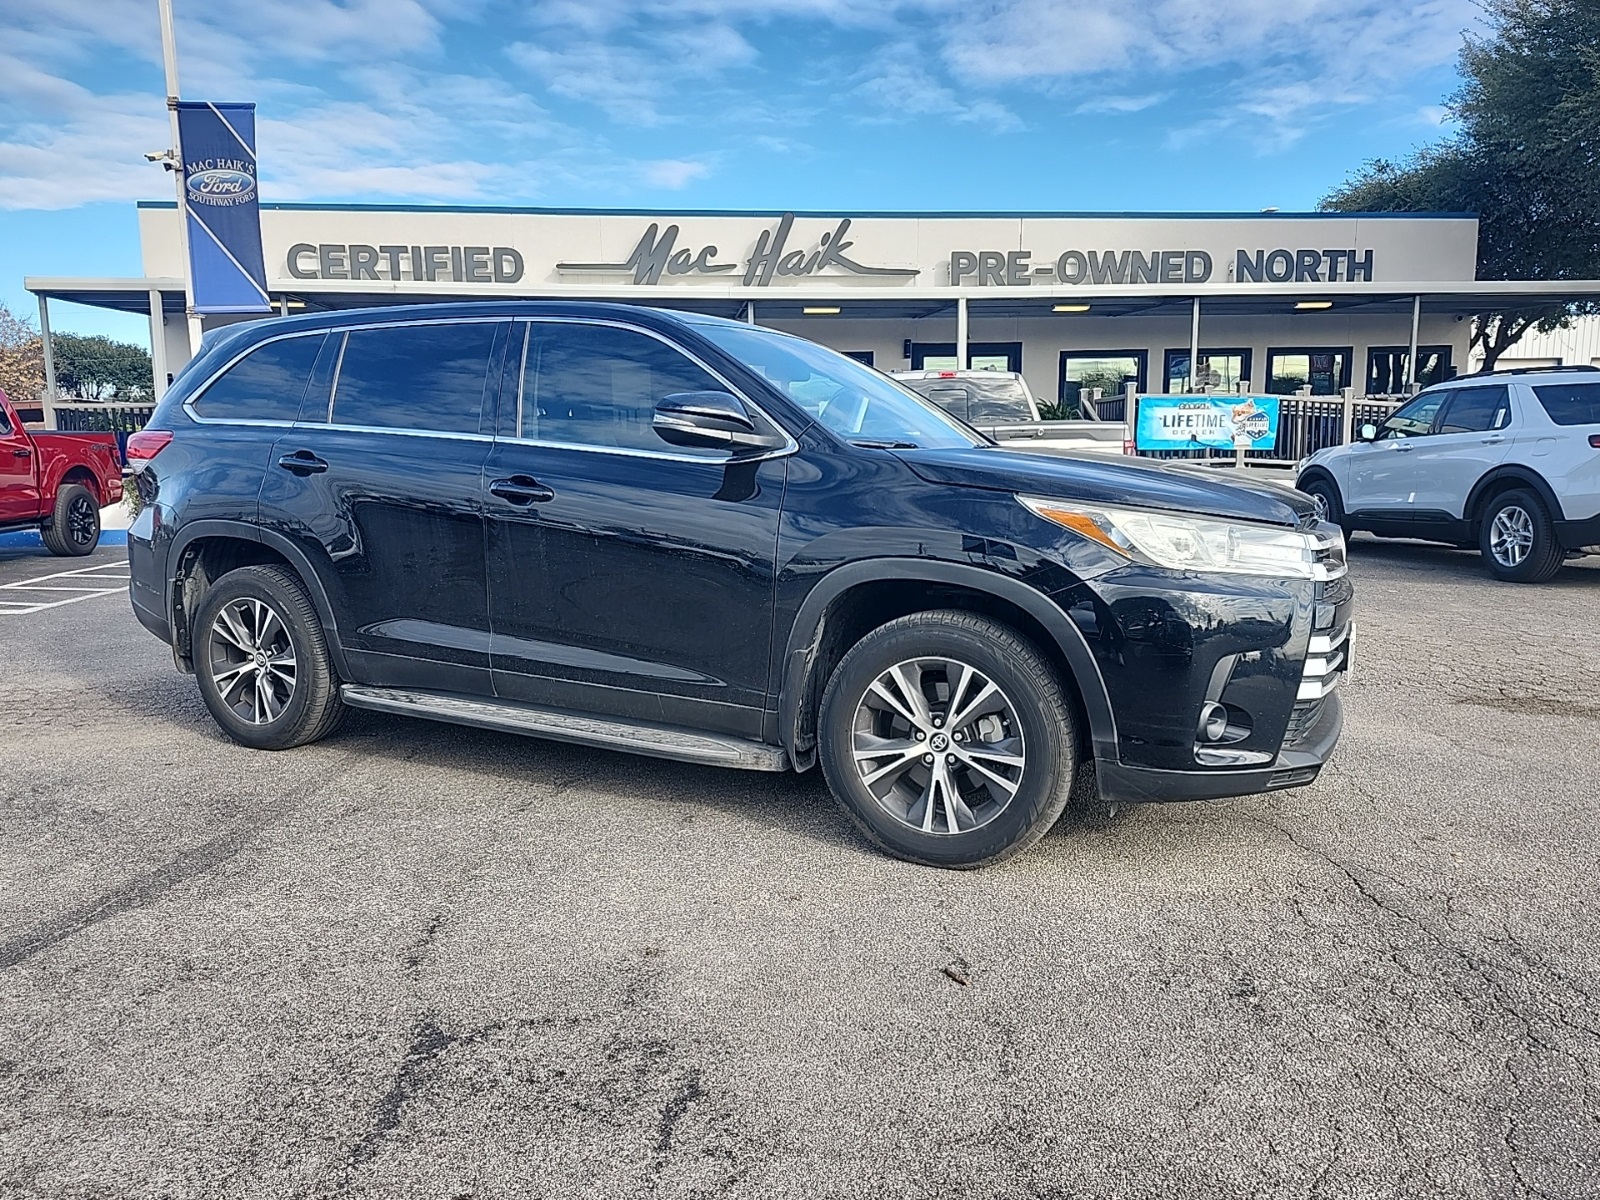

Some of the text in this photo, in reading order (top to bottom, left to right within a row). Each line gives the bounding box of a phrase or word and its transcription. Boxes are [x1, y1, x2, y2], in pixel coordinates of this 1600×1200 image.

[186, 158, 255, 174] MAC HAIK'S
[200, 173, 242, 193] Ford
[188, 191, 255, 206] SOUTHWAY FORD
[556, 211, 921, 287] Mac Haik
[286, 243, 524, 283] CERTIFIED
[950, 249, 1373, 285] PRE-OWNED NORTH
[1163, 414, 1226, 427] LIFETIME
